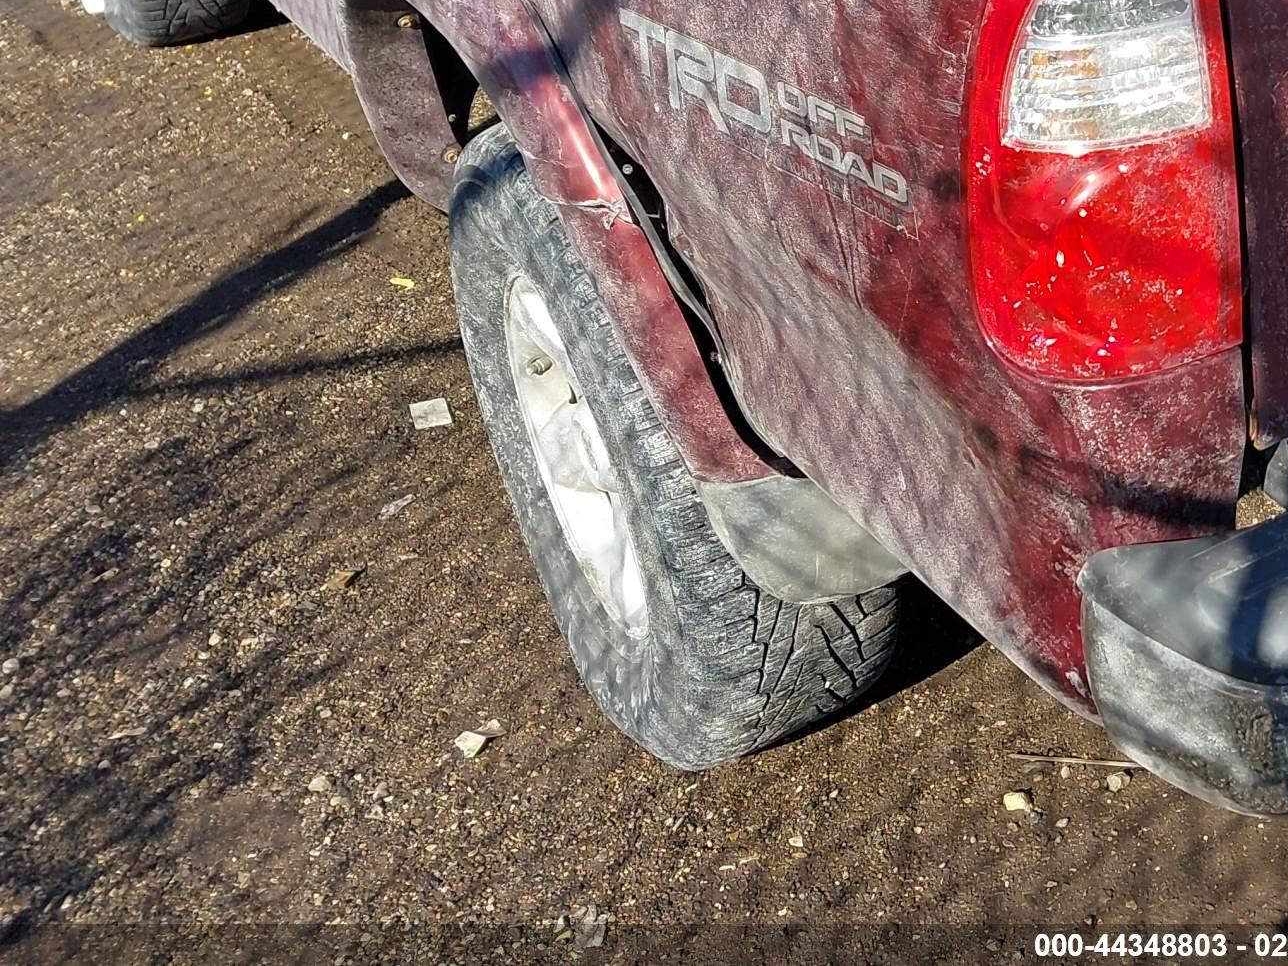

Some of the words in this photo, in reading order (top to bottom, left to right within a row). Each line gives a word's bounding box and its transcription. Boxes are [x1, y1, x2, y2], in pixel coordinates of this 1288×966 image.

[618, 7, 773, 135] TRD
[777, 80, 867, 137] OFF
[780, 118, 914, 206] ROAD
